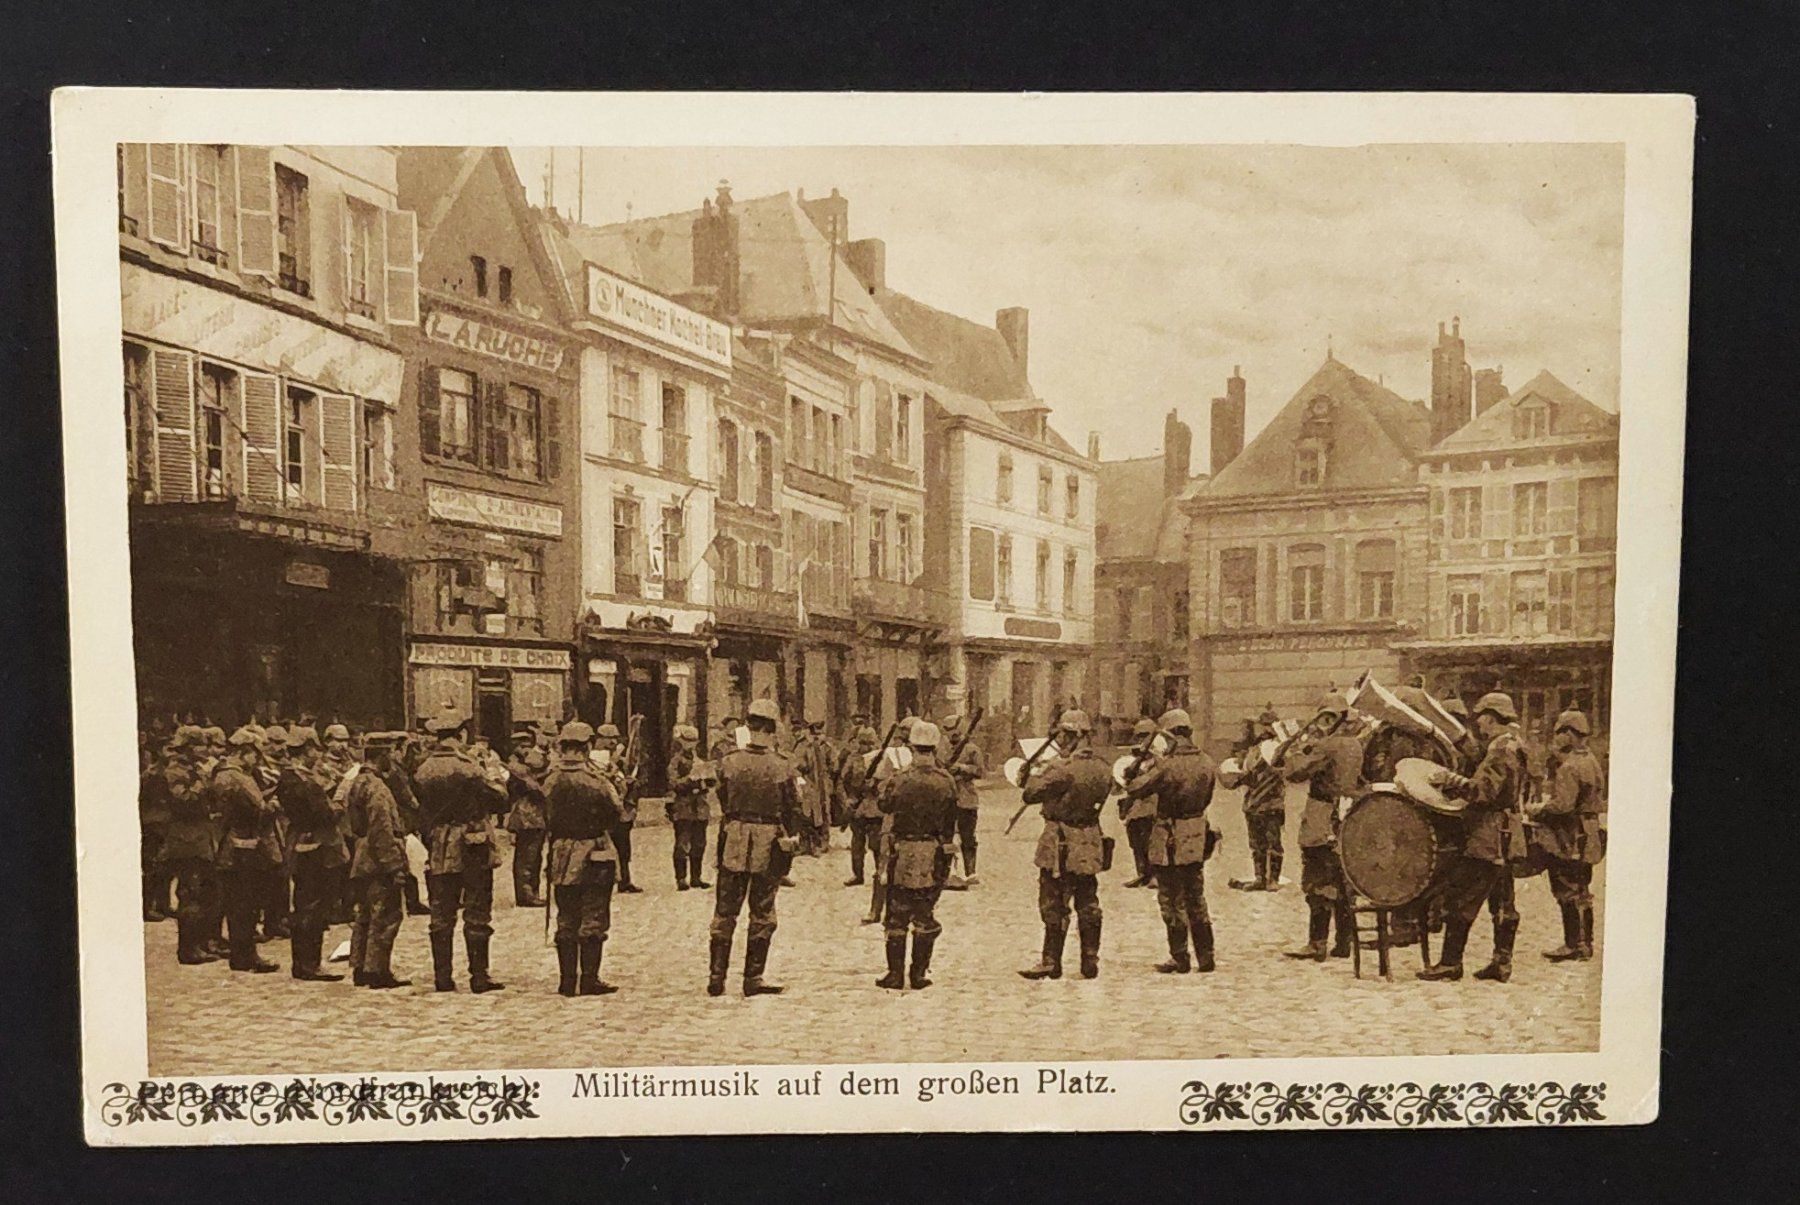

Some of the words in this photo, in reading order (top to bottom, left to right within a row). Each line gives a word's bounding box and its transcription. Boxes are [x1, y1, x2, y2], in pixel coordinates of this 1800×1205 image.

[572, 1071, 760, 1098] Militärmusik
[777, 1071, 822, 1097] auf
[839, 1071, 900, 1096] dem
[917, 1069, 1020, 1102] großen
[1036, 1068, 1117, 1094] Platz.
